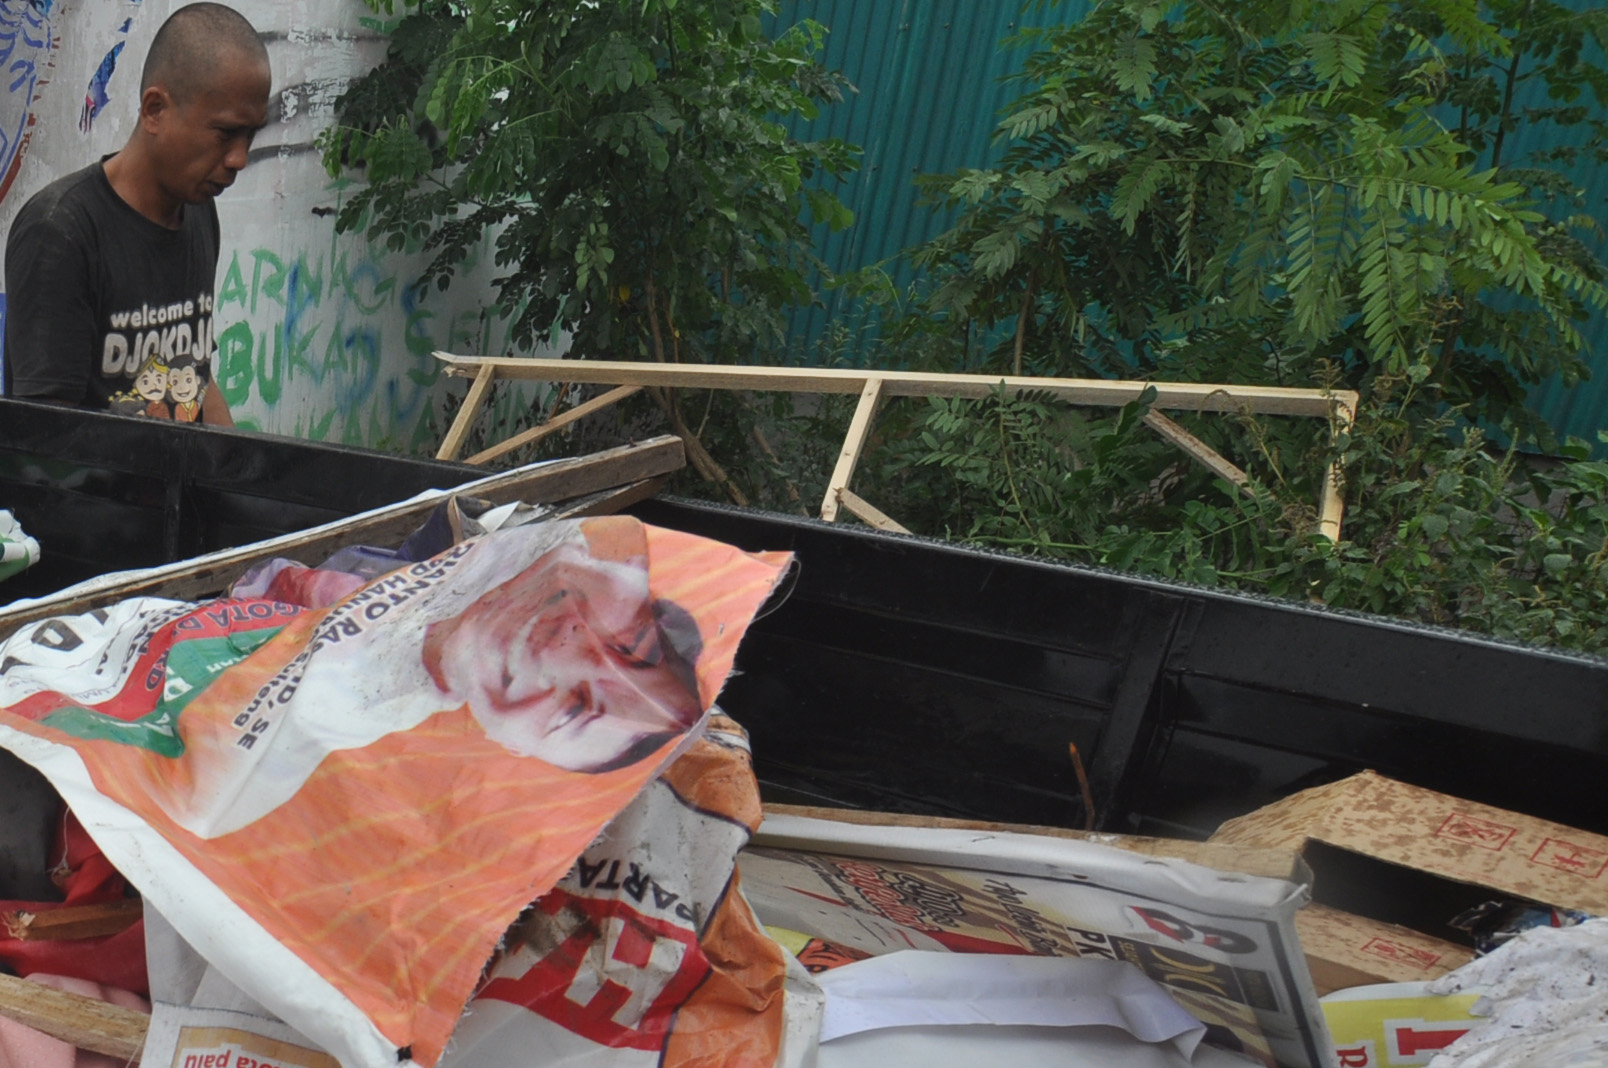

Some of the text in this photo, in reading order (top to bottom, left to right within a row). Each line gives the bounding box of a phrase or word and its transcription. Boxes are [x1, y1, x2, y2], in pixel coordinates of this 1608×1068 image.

[110, 292, 213, 328] welcome to
[102, 317, 213, 374] DJOKDJ
[237, 717, 271, 750] SE
[576, 856, 694, 924] PARTA
